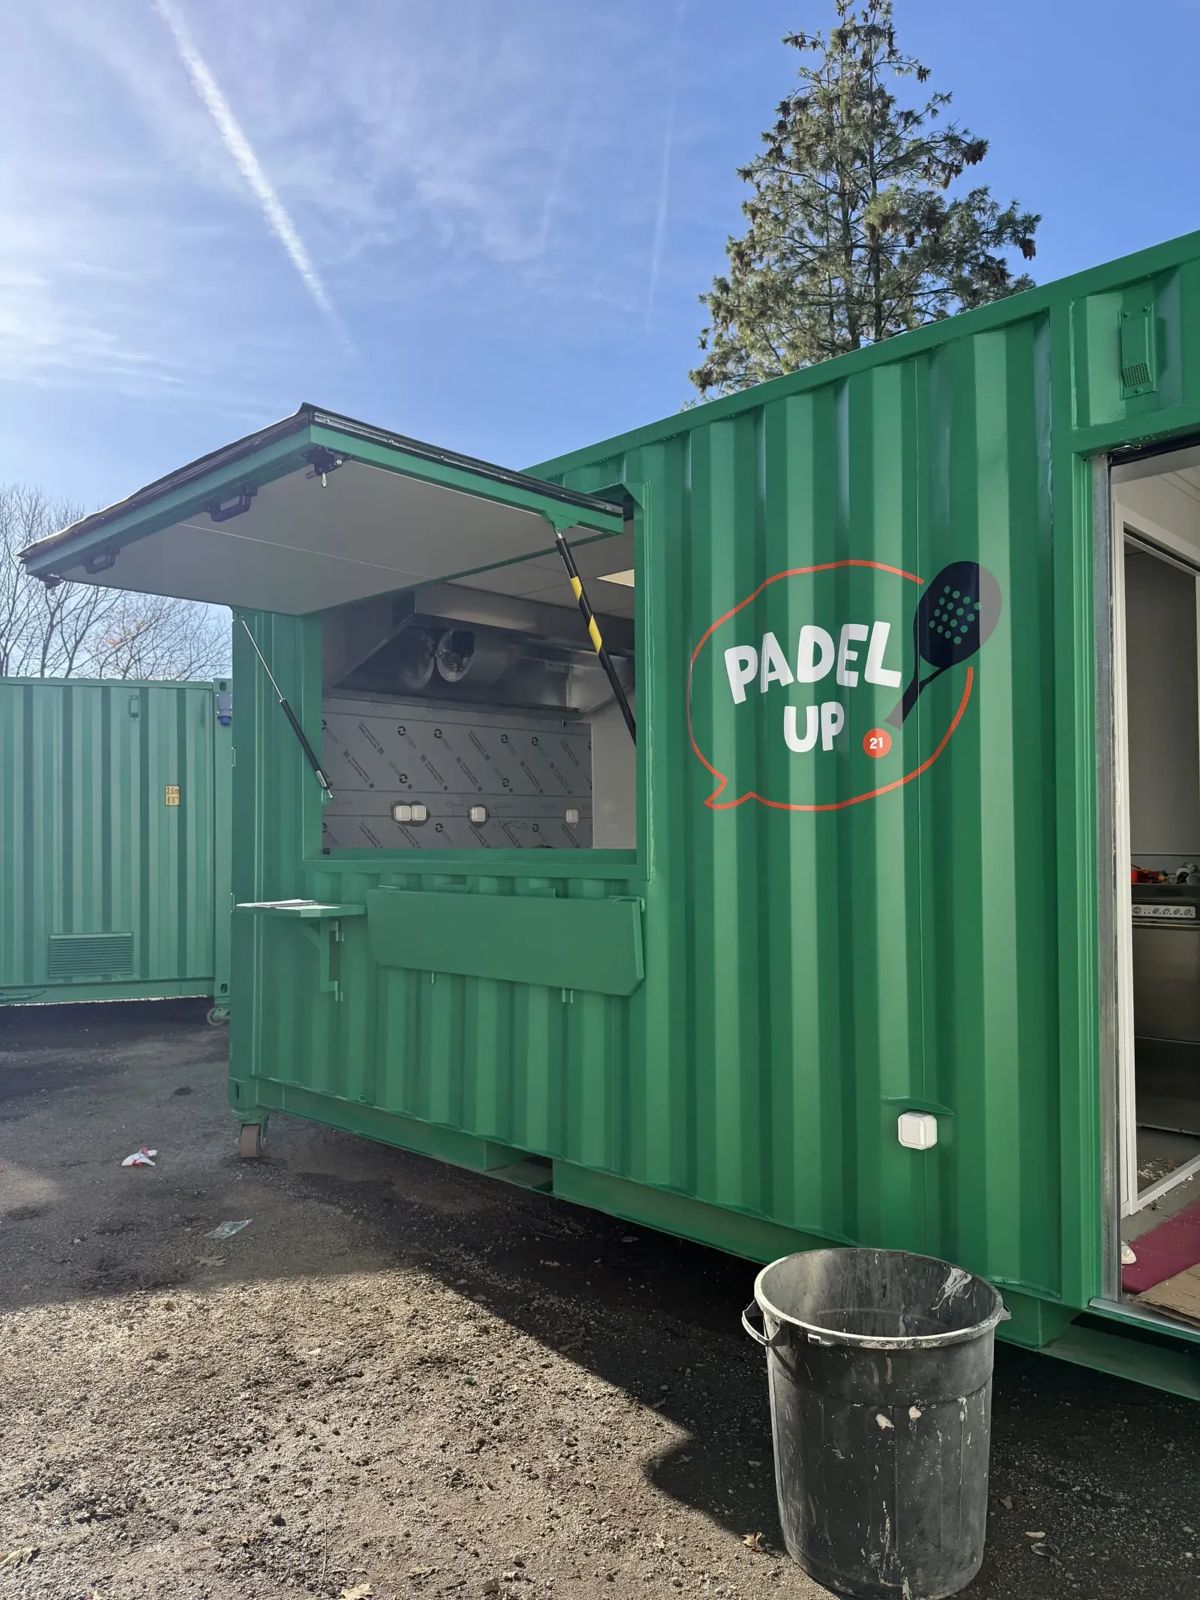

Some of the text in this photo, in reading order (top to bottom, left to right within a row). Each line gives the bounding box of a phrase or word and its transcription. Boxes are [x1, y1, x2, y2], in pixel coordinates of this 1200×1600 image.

[724, 621, 901, 704] PADEL
[784, 701, 844, 752] UP
[869, 736, 883, 750] 21
